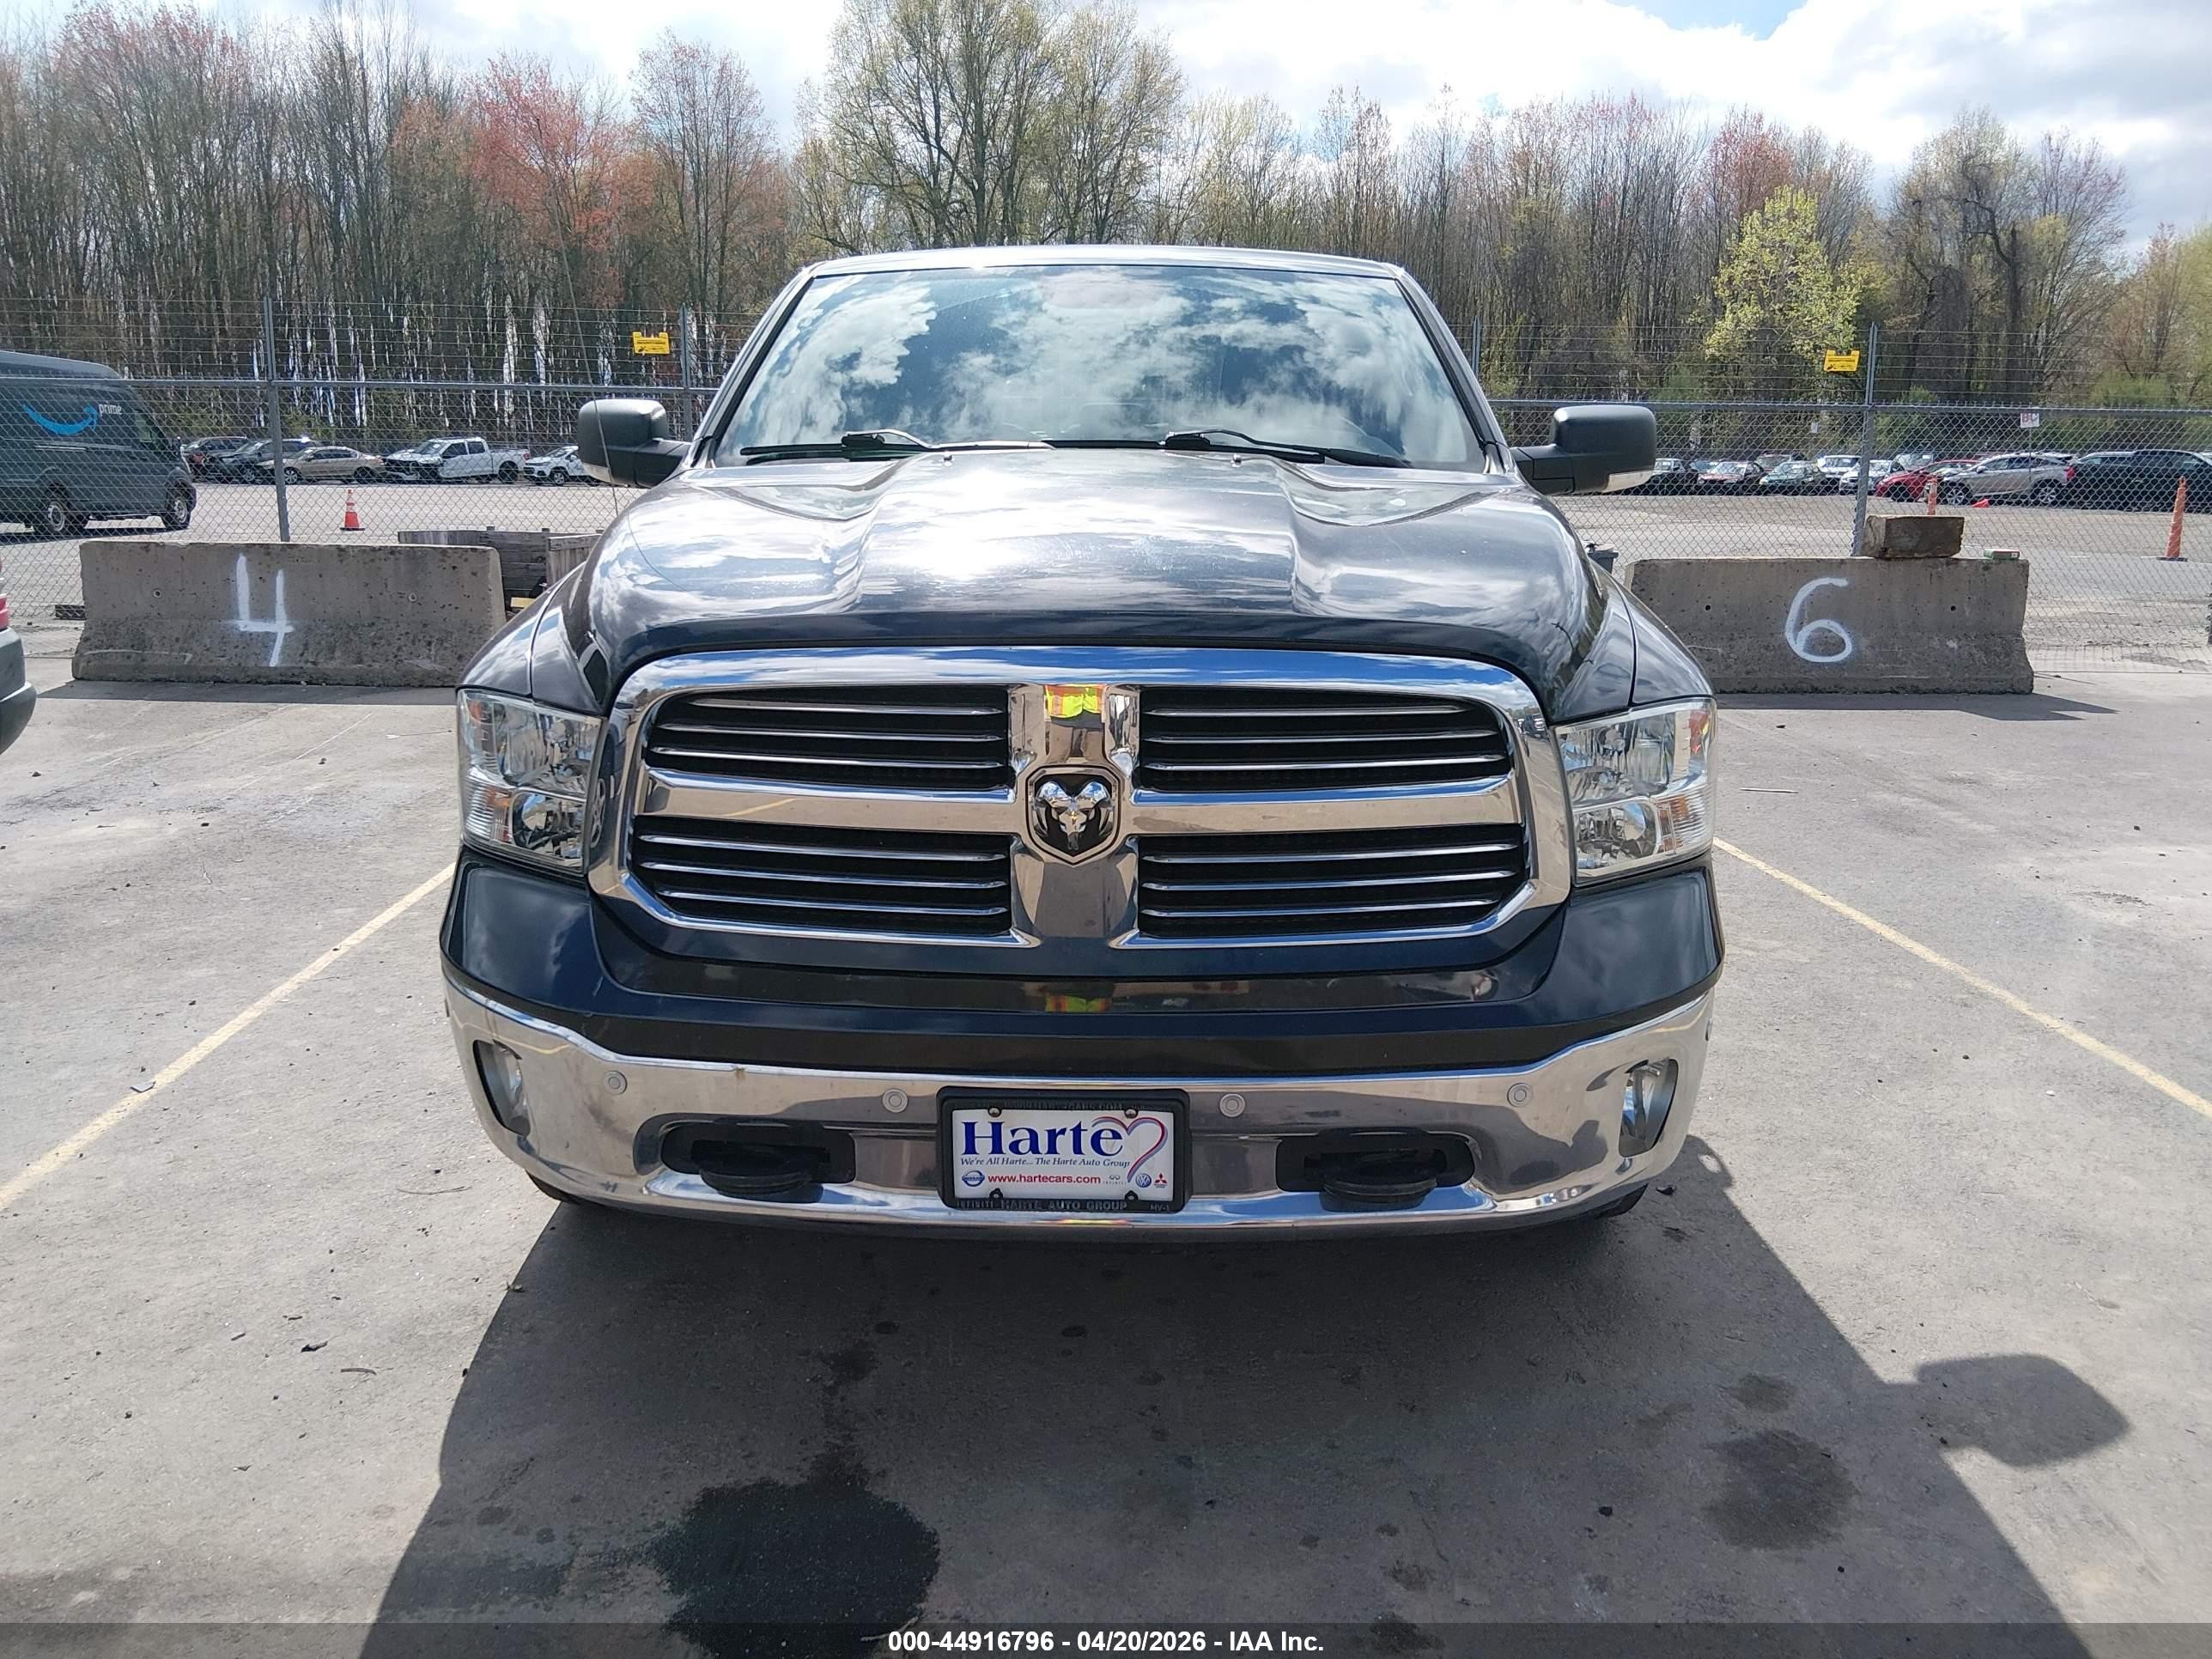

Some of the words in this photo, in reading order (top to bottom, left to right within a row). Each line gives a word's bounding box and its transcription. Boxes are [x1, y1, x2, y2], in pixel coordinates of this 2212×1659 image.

[99, 404, 123, 416] prime
[235, 552, 295, 667] 4
[1785, 577, 1852, 663] 6
[961, 1120, 1123, 1157] Harte
[961, 1157, 984, 1165] We're
[987, 1157, 1000, 1165] All
[1036, 1157, 1052, 1165] The
[1053, 1158, 1077, 1166] Harte
[1103, 1158, 1130, 1169] Group
[988, 1173, 1101, 1184] www.hartecars.com
[1048, 1200, 1080, 1210] AUTO
[1086, 1200, 1127, 1210] GROUP
